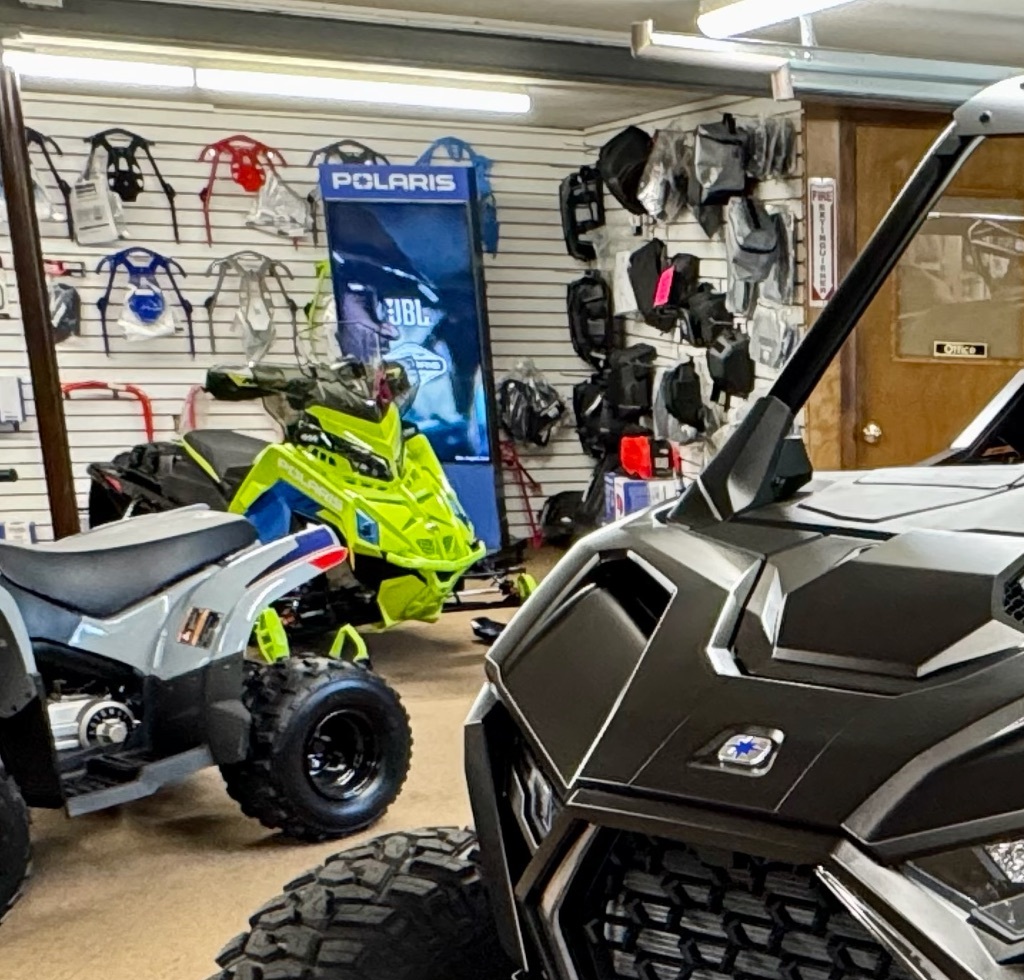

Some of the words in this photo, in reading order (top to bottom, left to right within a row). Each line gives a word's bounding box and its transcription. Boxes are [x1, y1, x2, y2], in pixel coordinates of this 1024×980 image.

[331, 172, 457, 192] POLARIS
[812, 190, 832, 202] FIRE
[384, 298, 431, 327] JBL
[943, 344, 977, 355] Office
[277, 457, 343, 511] POLARIS
